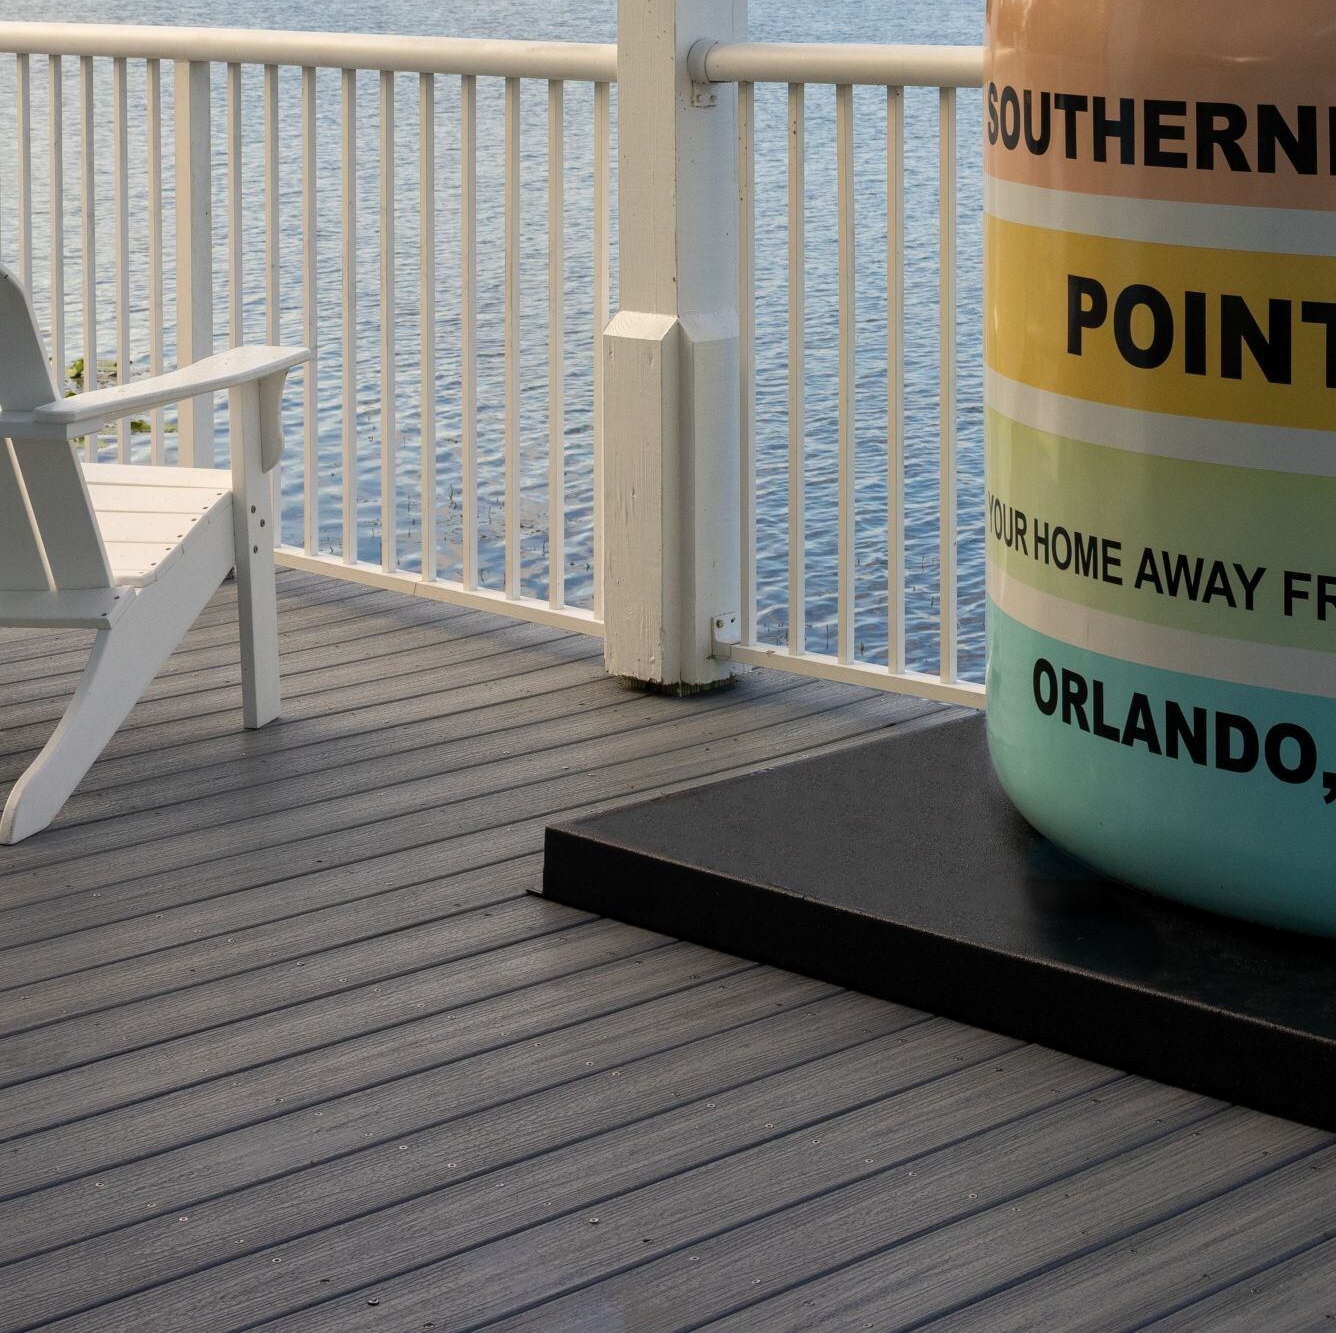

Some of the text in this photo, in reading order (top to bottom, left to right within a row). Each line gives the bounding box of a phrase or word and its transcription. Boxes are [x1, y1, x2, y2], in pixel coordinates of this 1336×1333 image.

[987, 82, 1336, 176] SOUTHERN
[987, 490, 1028, 556] YOUR
[1034, 518, 1123, 586] HOME
[1134, 547, 1267, 611] AWAY
[1033, 658, 1336, 805] ORLANDO,
